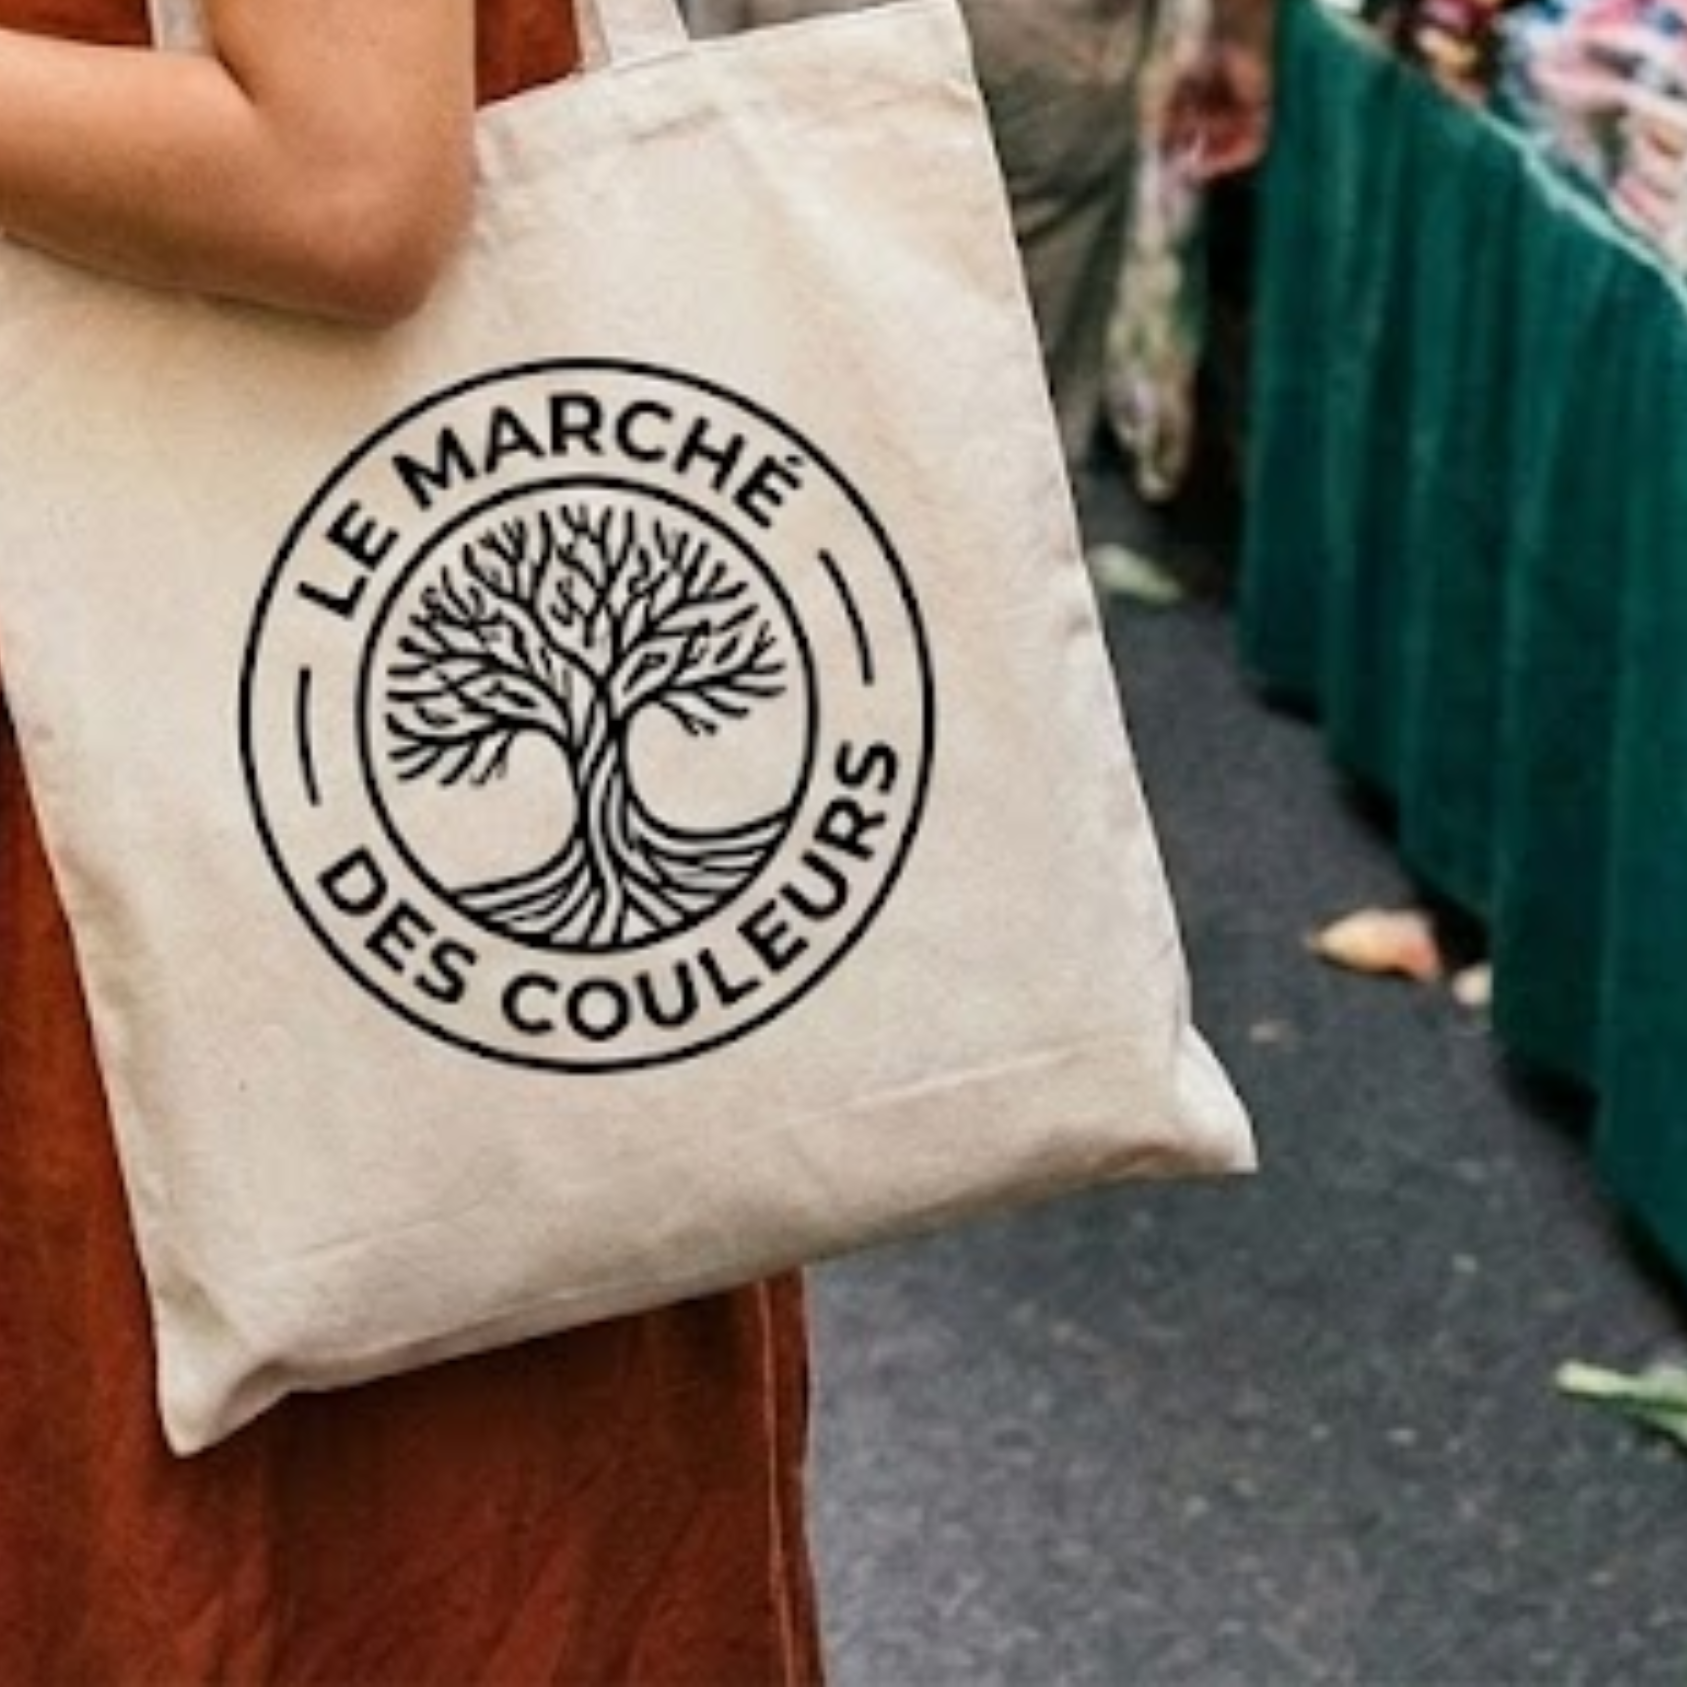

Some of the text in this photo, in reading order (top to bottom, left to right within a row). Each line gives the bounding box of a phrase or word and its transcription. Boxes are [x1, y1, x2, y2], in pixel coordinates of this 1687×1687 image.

[296, 392, 803, 619] LE MARCHÉ
[316, 741, 899, 1043] DES COULEURS
